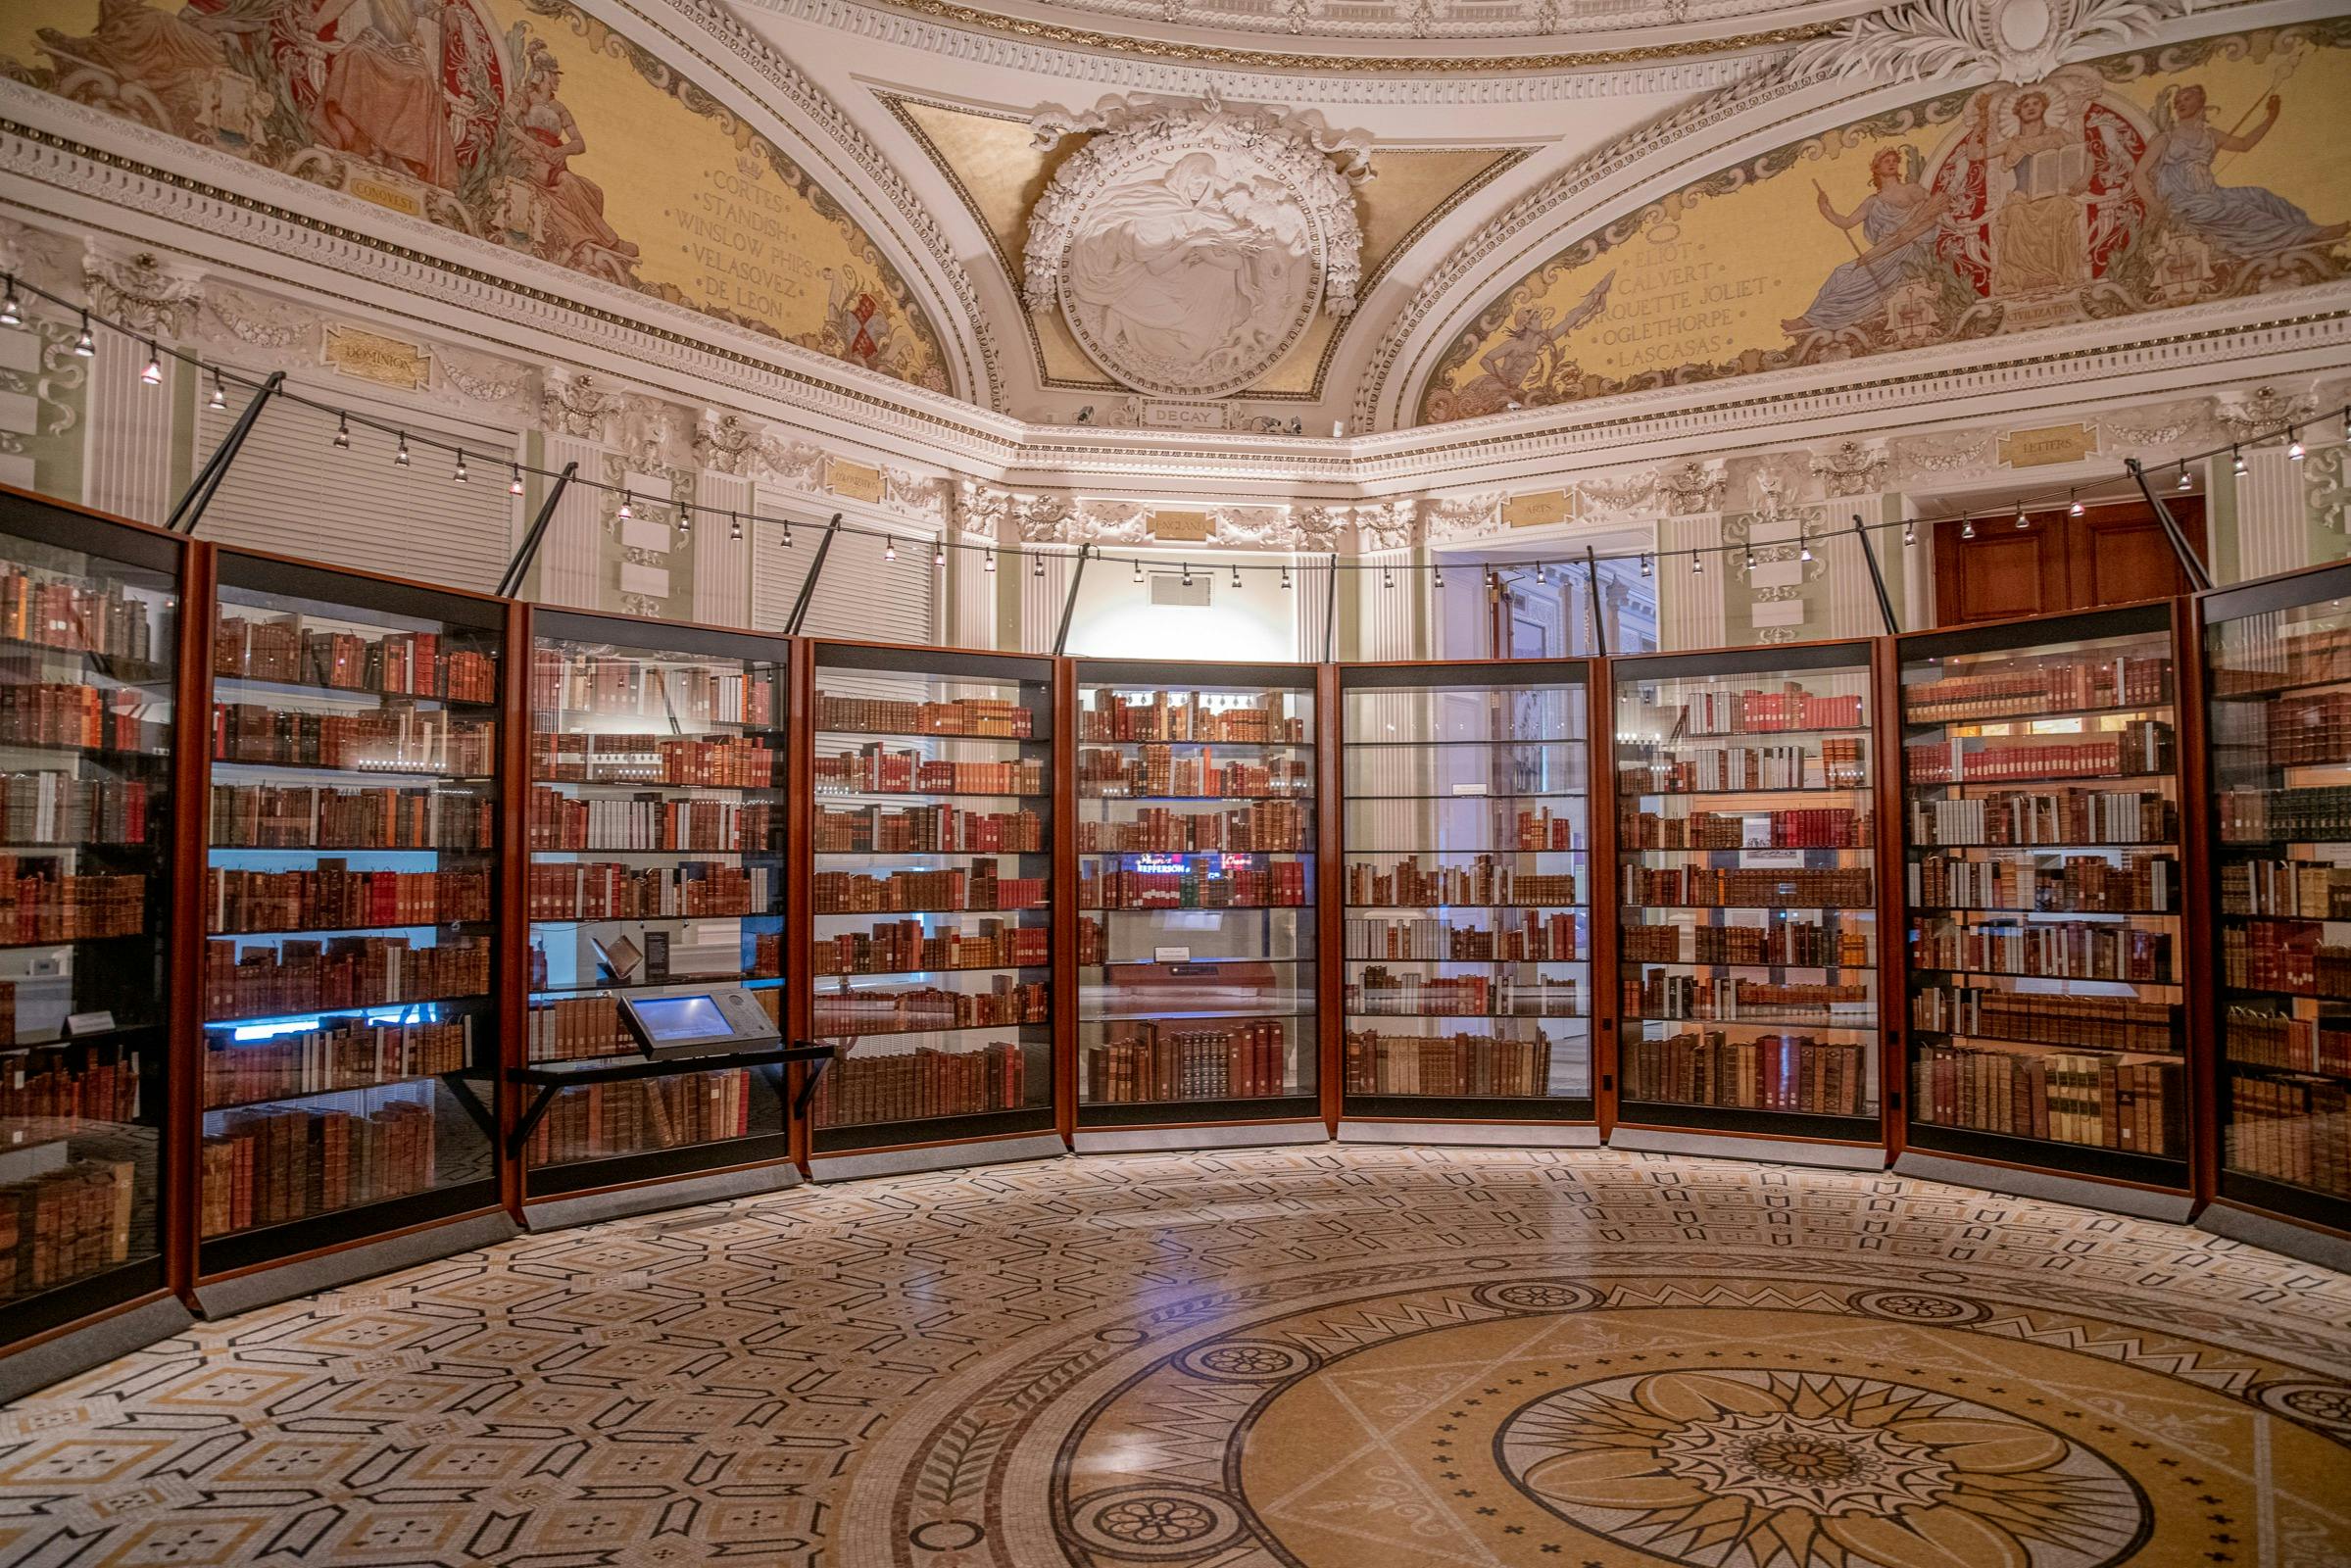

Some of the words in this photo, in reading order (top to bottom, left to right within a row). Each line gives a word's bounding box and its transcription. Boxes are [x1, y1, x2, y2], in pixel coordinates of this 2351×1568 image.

[713, 169, 783, 214] CORTES
[703, 193, 789, 243] STANDISH
[676, 208, 763, 258] WINSLOW
[771, 247, 813, 278] PHIPS
[1636, 243, 1692, 270] ELIOT
[1618, 263, 1713, 295] CALVERT
[706, 276, 728, 300] DE
[737, 288, 783, 318] LEON
[1595, 291, 1690, 324] RQUETTE
[1699, 277, 1769, 305] JOLIET
[2007, 304, 2077, 321] CIVILIZATION
[1602, 309, 1734, 347] OGLETHORPE
[346, 346, 413, 371] DOMINION
[1156, 410, 1211, 422] DECAY
[2024, 439, 2072, 454] LETTERS
